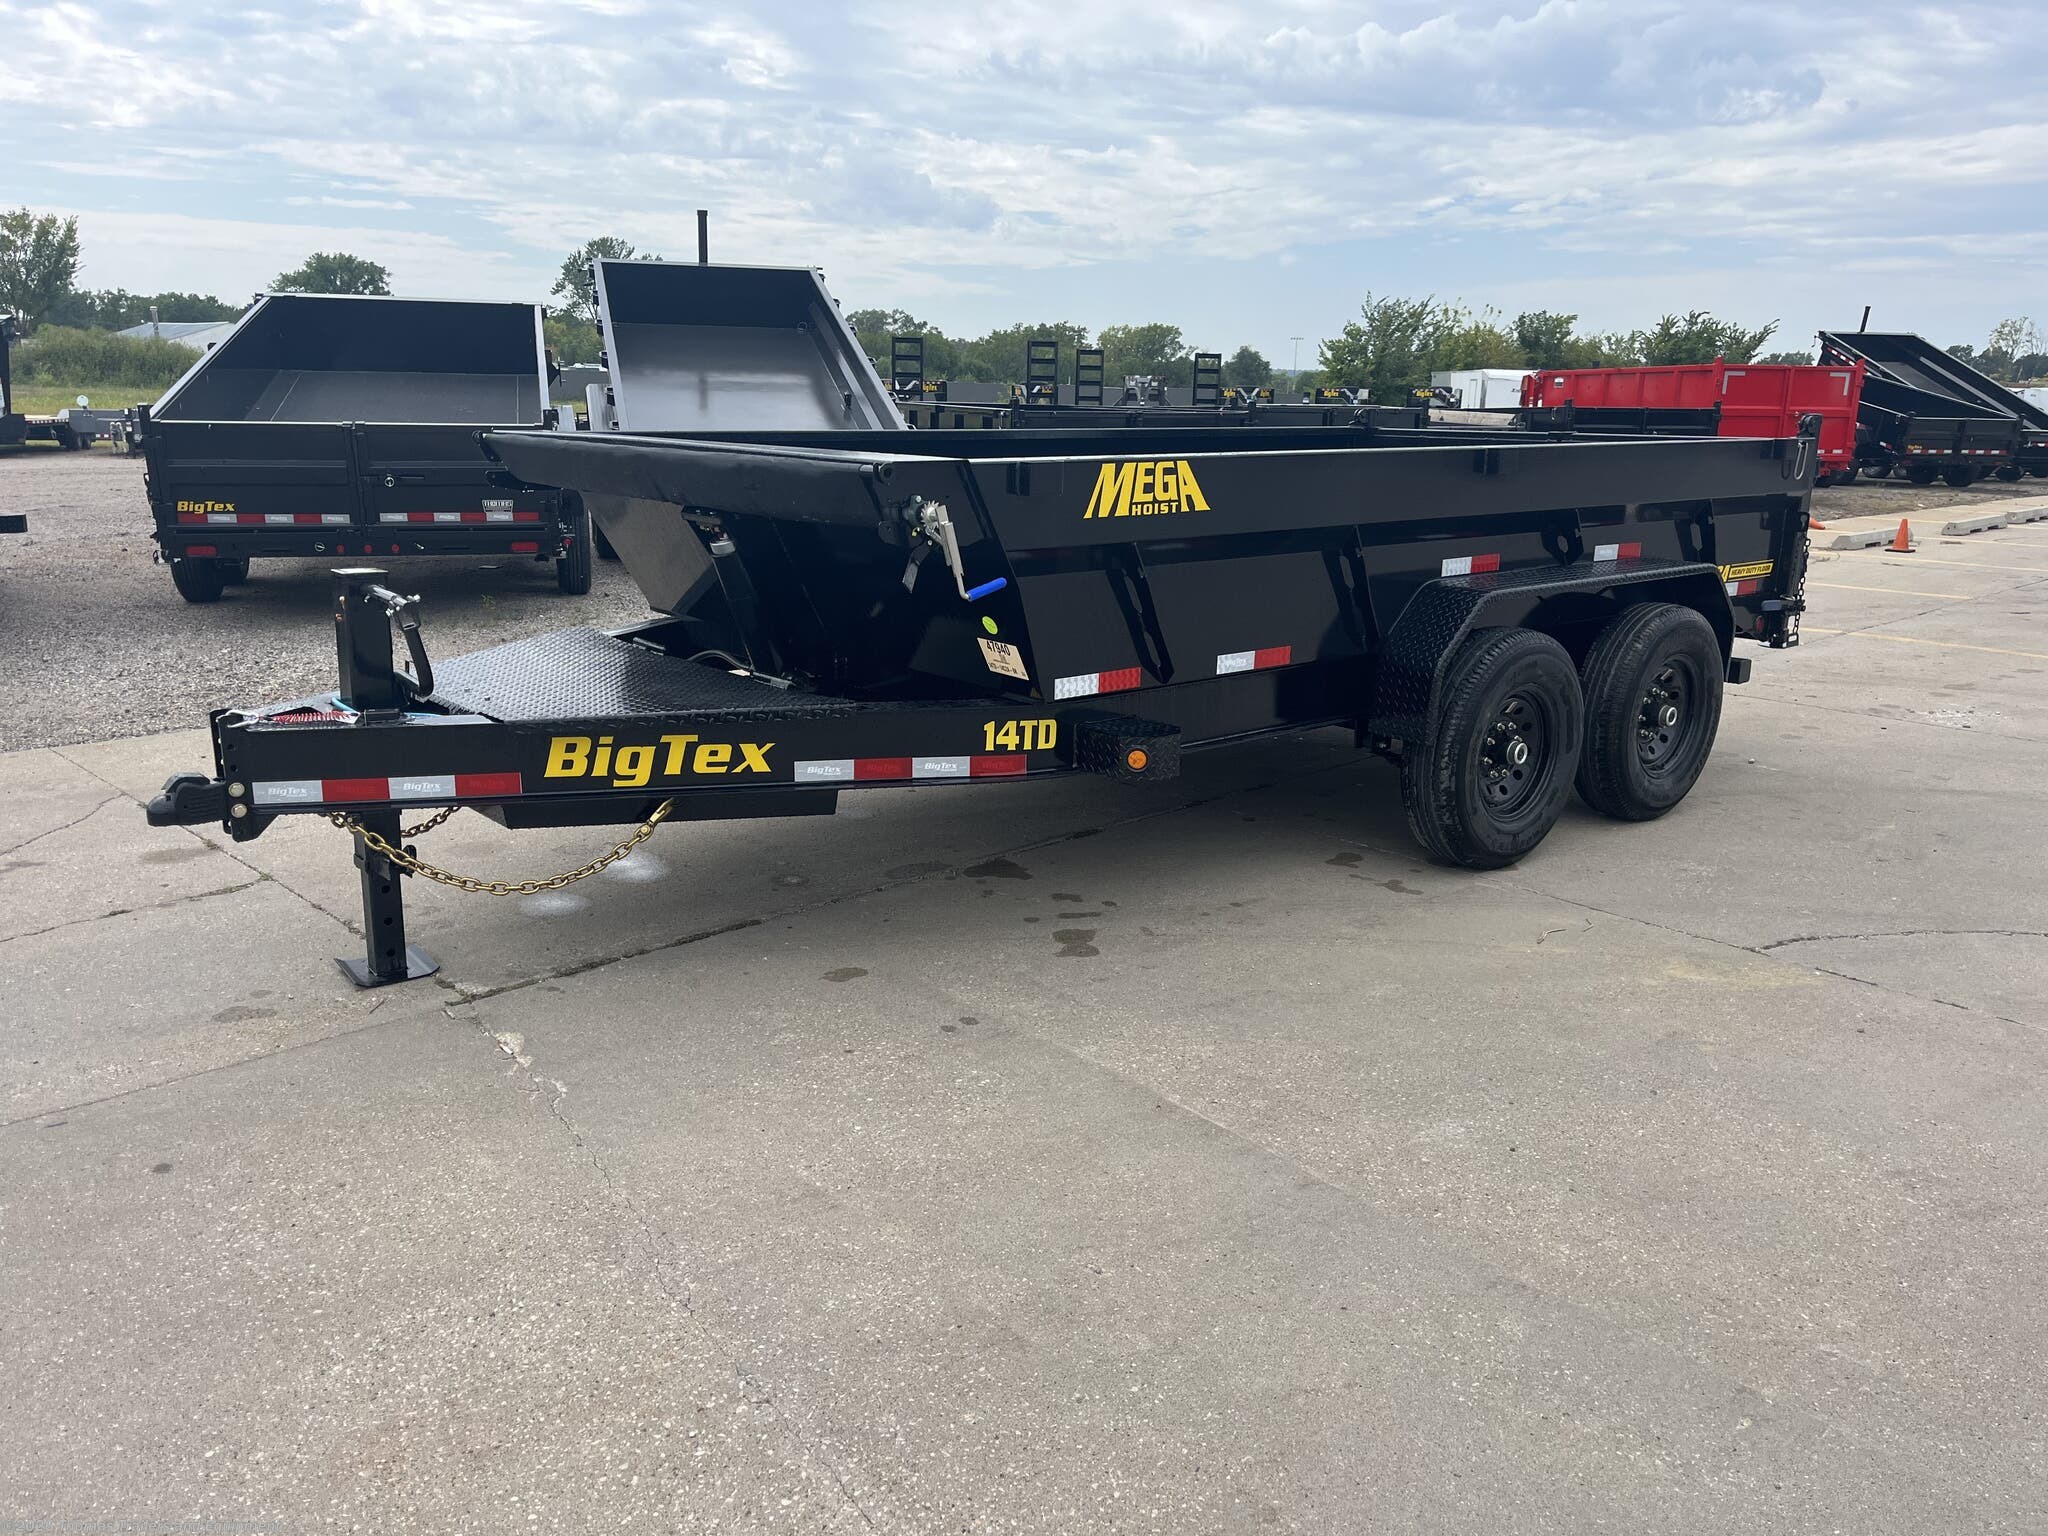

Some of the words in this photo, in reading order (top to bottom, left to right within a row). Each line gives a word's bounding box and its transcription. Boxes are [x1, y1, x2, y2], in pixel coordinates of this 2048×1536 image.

[1083, 460, 1211, 519] MEGA
[177, 500, 235, 514] BigTex
[1131, 502, 1179, 516] HOIST
[986, 640, 1011, 656] 47940
[983, 719, 1057, 751] 14TD
[543, 734, 776, 787] BigTex
[924, 761, 958, 771] BigTex
[806, 765, 842, 775] BigTex
[268, 786, 308, 797] BigTex
[402, 781, 441, 792] BigTex
